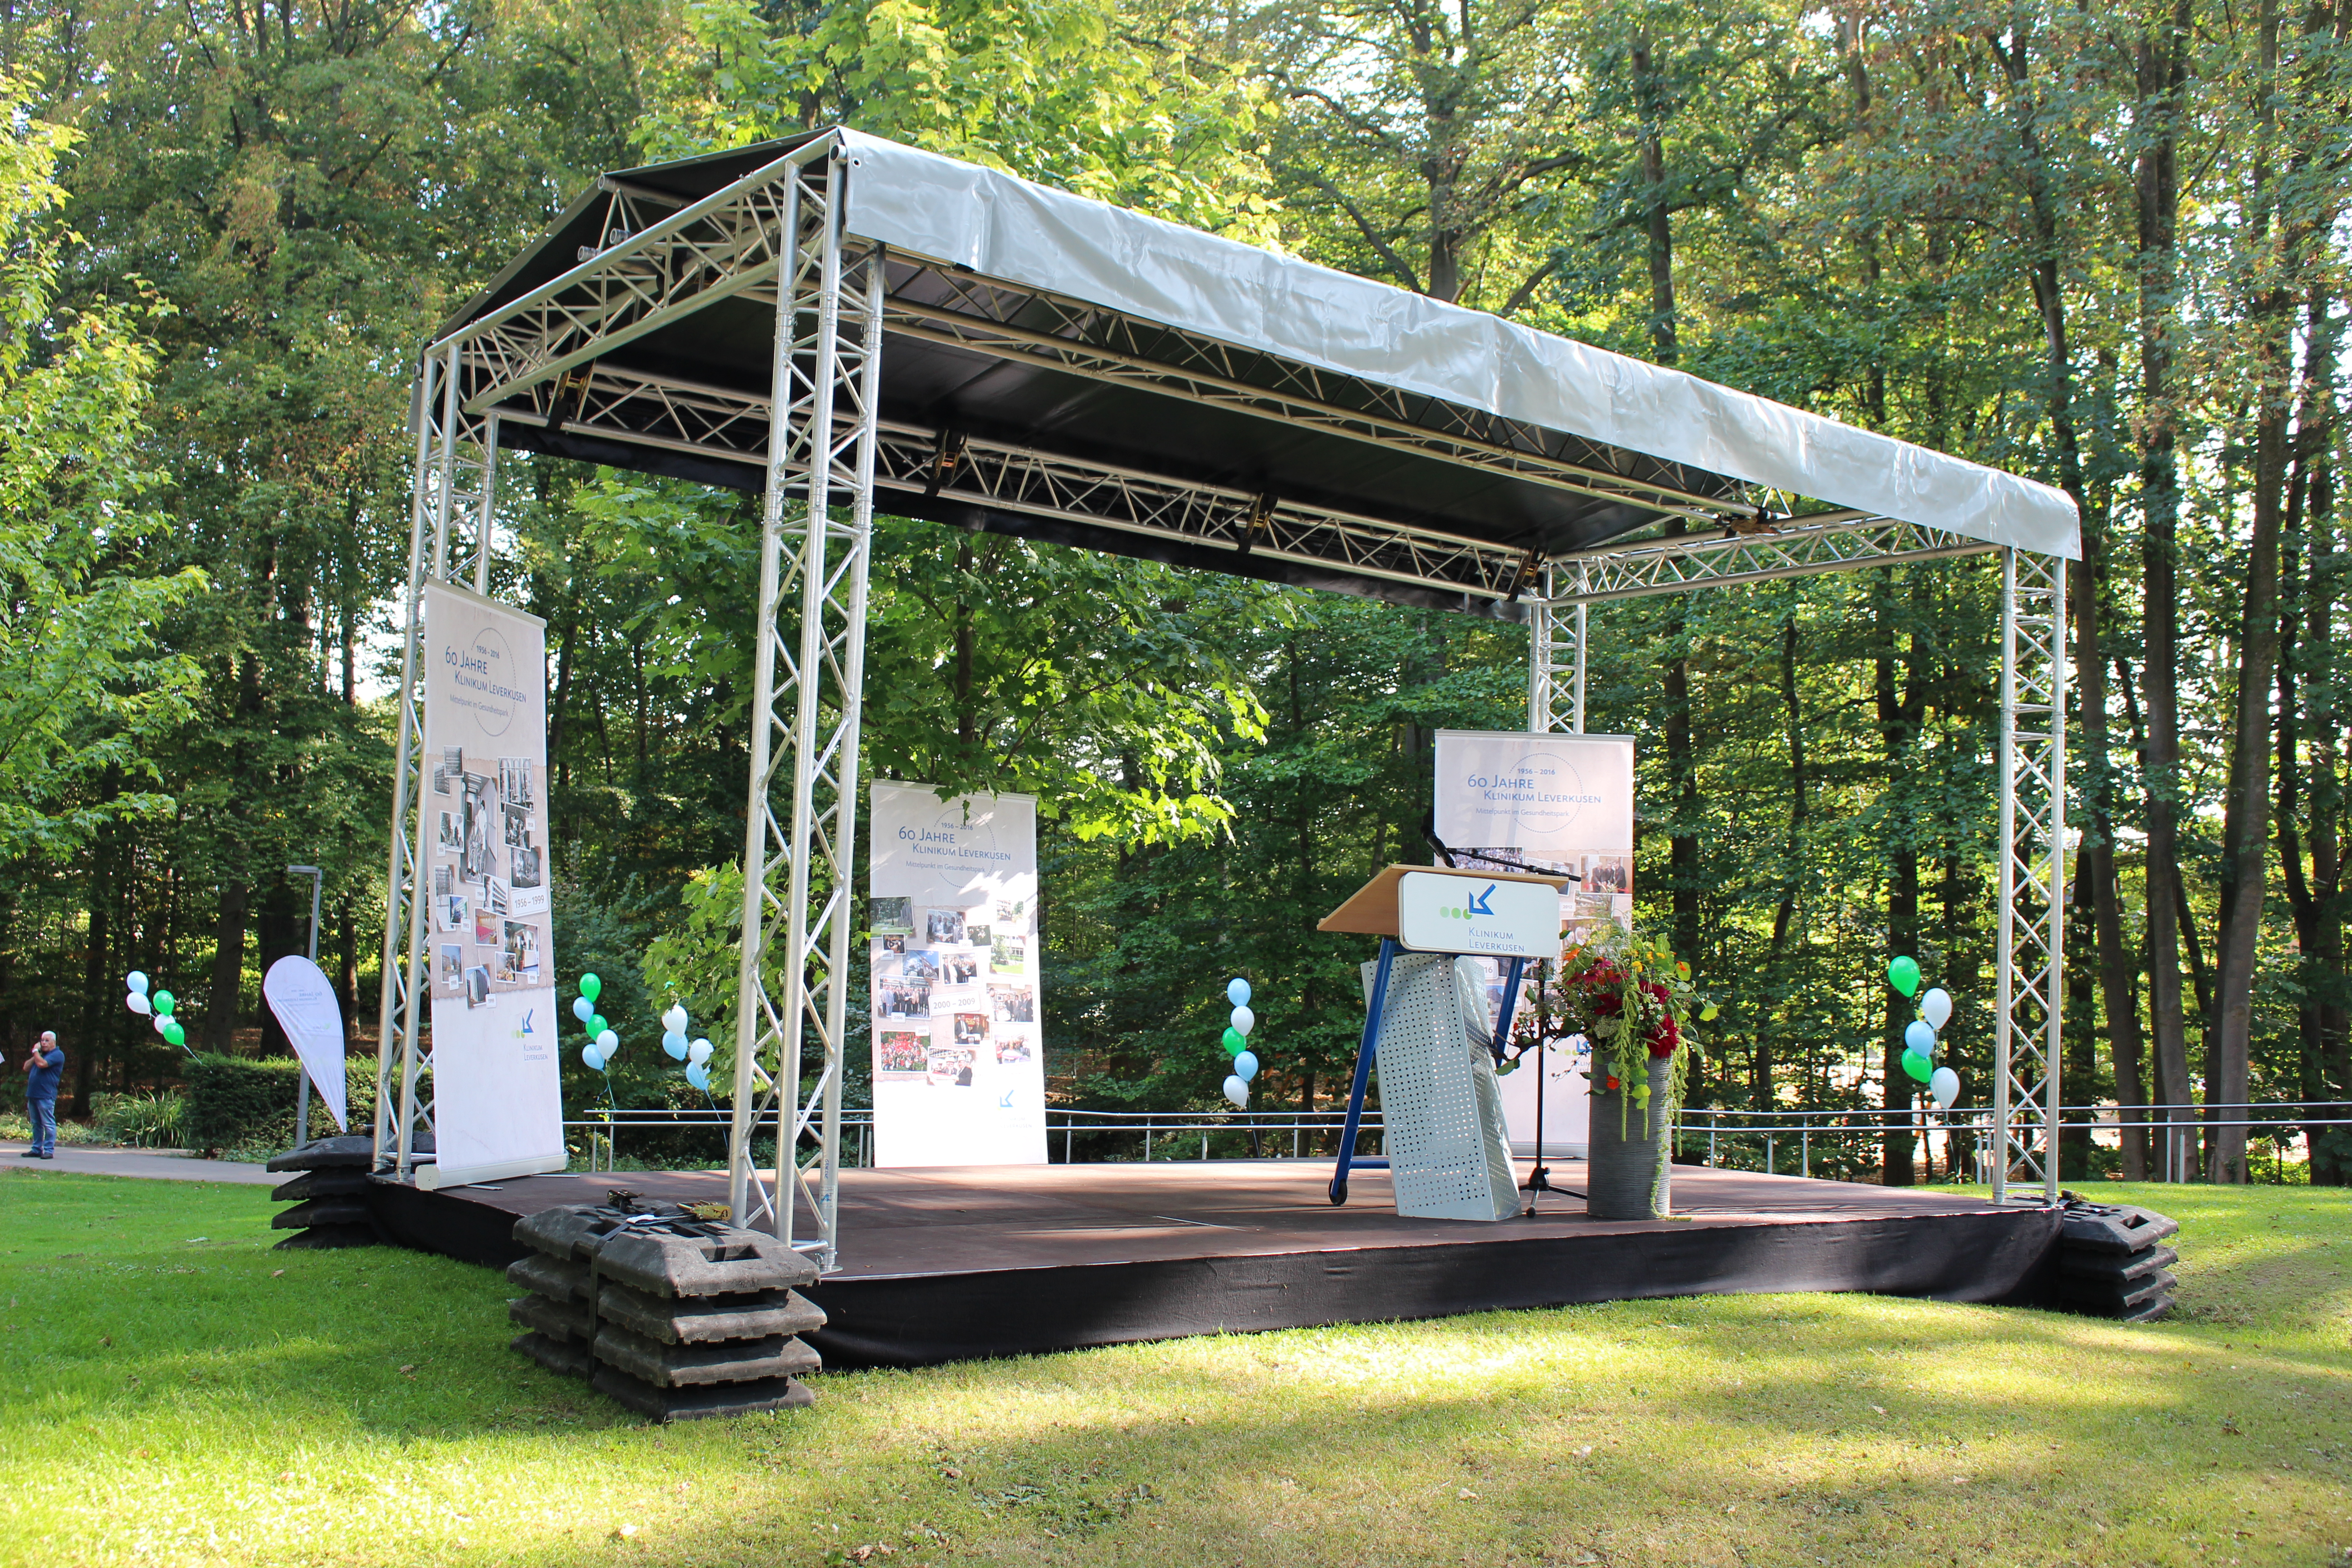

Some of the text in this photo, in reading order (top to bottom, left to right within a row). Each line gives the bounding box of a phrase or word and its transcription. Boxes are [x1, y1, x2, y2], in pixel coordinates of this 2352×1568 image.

[476, 645, 487, 655] 1956
[490, 649, 500, 659] 2016
[446, 646, 488, 675] 60 JAHRE
[455, 670, 527, 703] KLINIKUM LEVERKUSEN
[450, 694, 472, 707] Mittelpunkt
[478, 702, 509, 717] Gesundheitspark
[1468, 774, 1534, 789] 60 JAHRE
[1484, 790, 1601, 803] KLINIKUM LEVERKUSEN
[1521, 809, 1569, 817] Gesundheitspark
[899, 826, 956, 843] 60 JAHRE
[913, 843, 1011, 861] KLINIKUM LEVERKUSEN
[906, 861, 936, 869] Mittelpunkt
[944, 863, 985, 873] Gesundheitspark
[514, 898, 527, 908] 1956
[532, 895, 544, 905] 1999
[1468, 927, 1514, 940] KLINIKUM
[1469, 938, 1525, 952] LEVERKUSEN
[933, 1001, 951, 1009] 2000
[958, 998, 975, 1006] 2009
